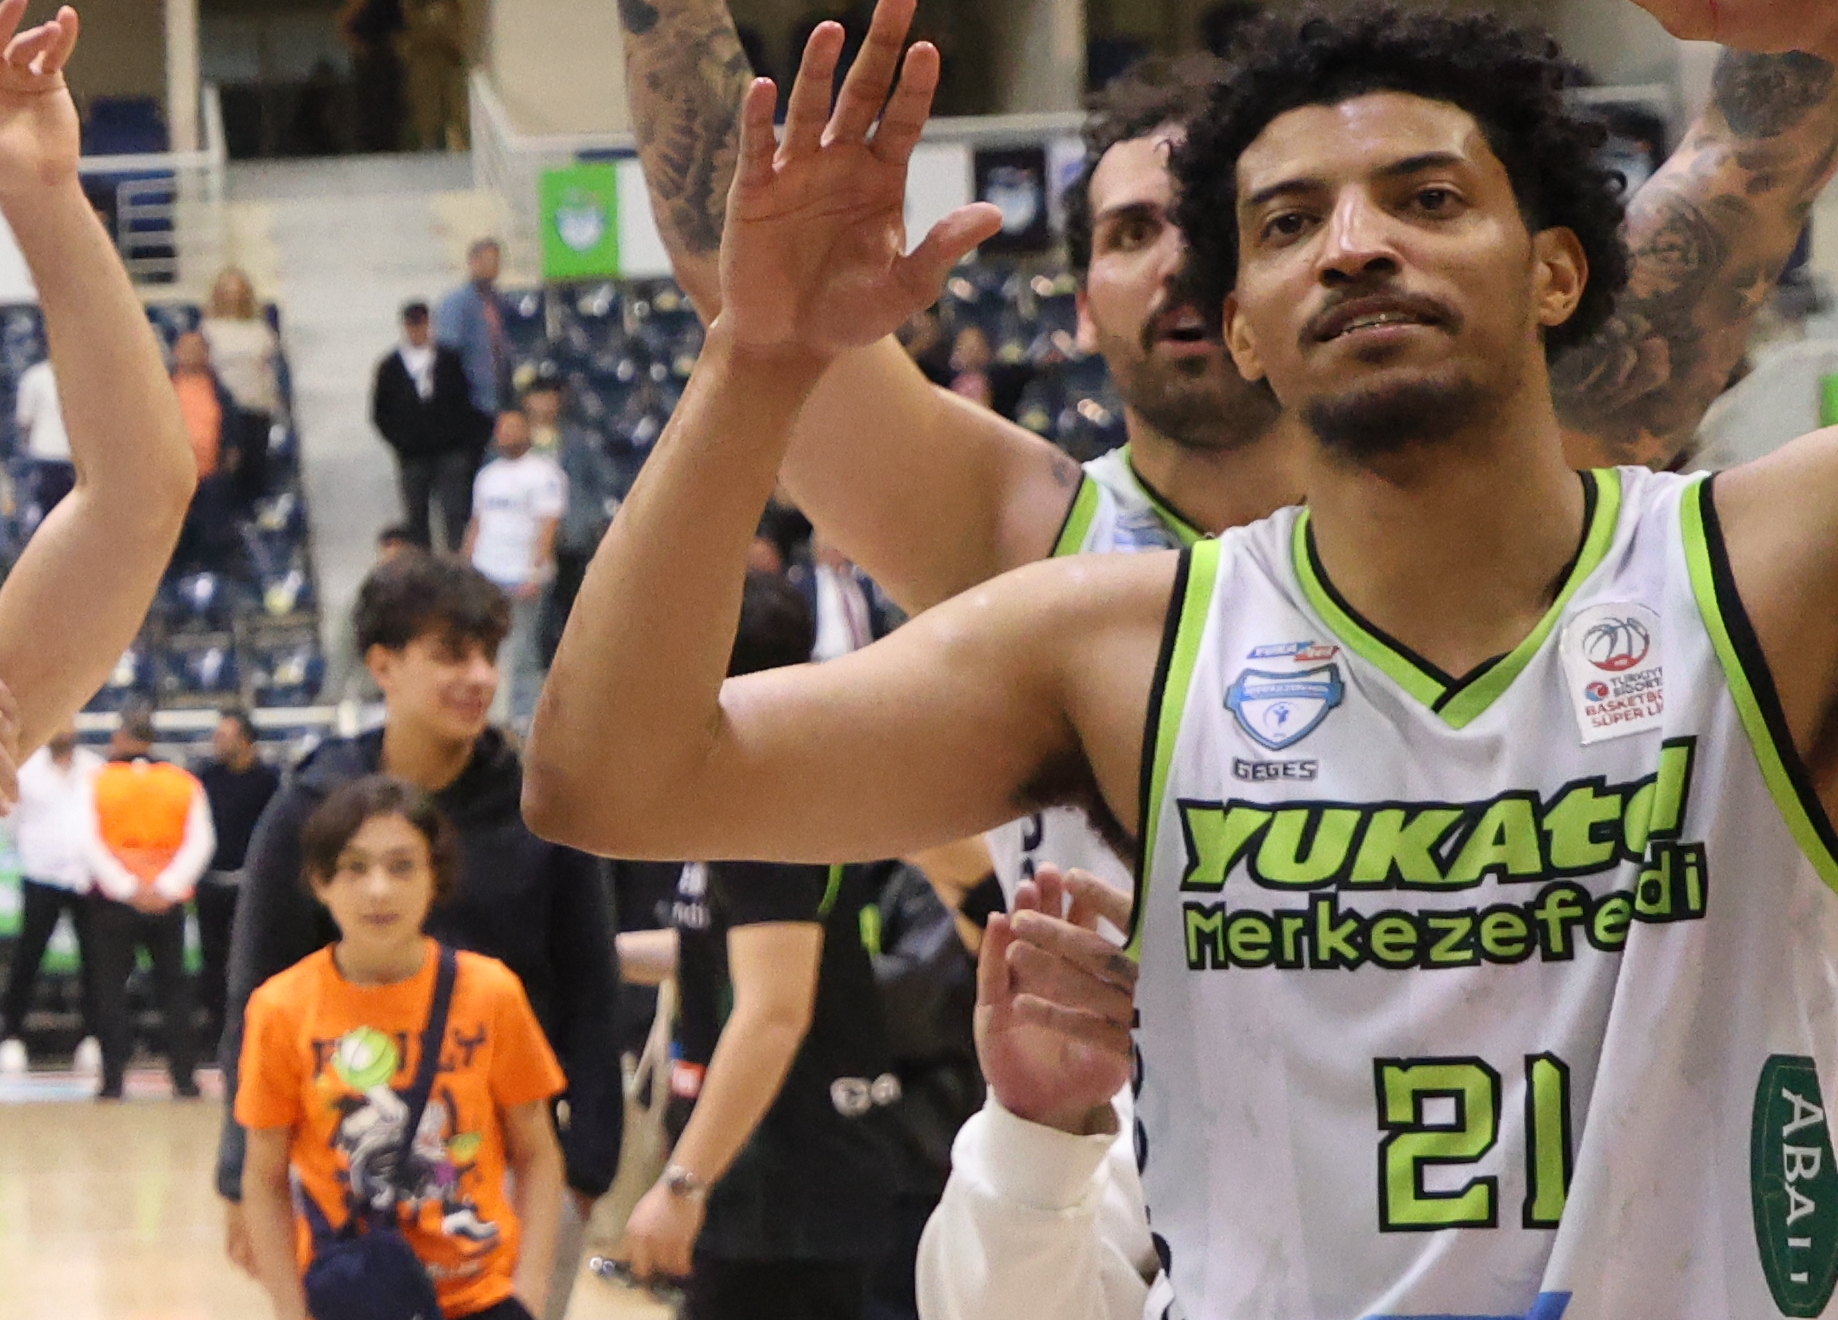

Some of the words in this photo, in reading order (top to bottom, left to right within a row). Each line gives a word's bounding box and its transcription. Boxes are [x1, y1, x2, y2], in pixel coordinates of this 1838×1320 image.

[1233, 758, 1318, 780] GEGES
[1183, 841, 1707, 970] Merkezefedi
[1373, 1051, 1572, 1233] 21
